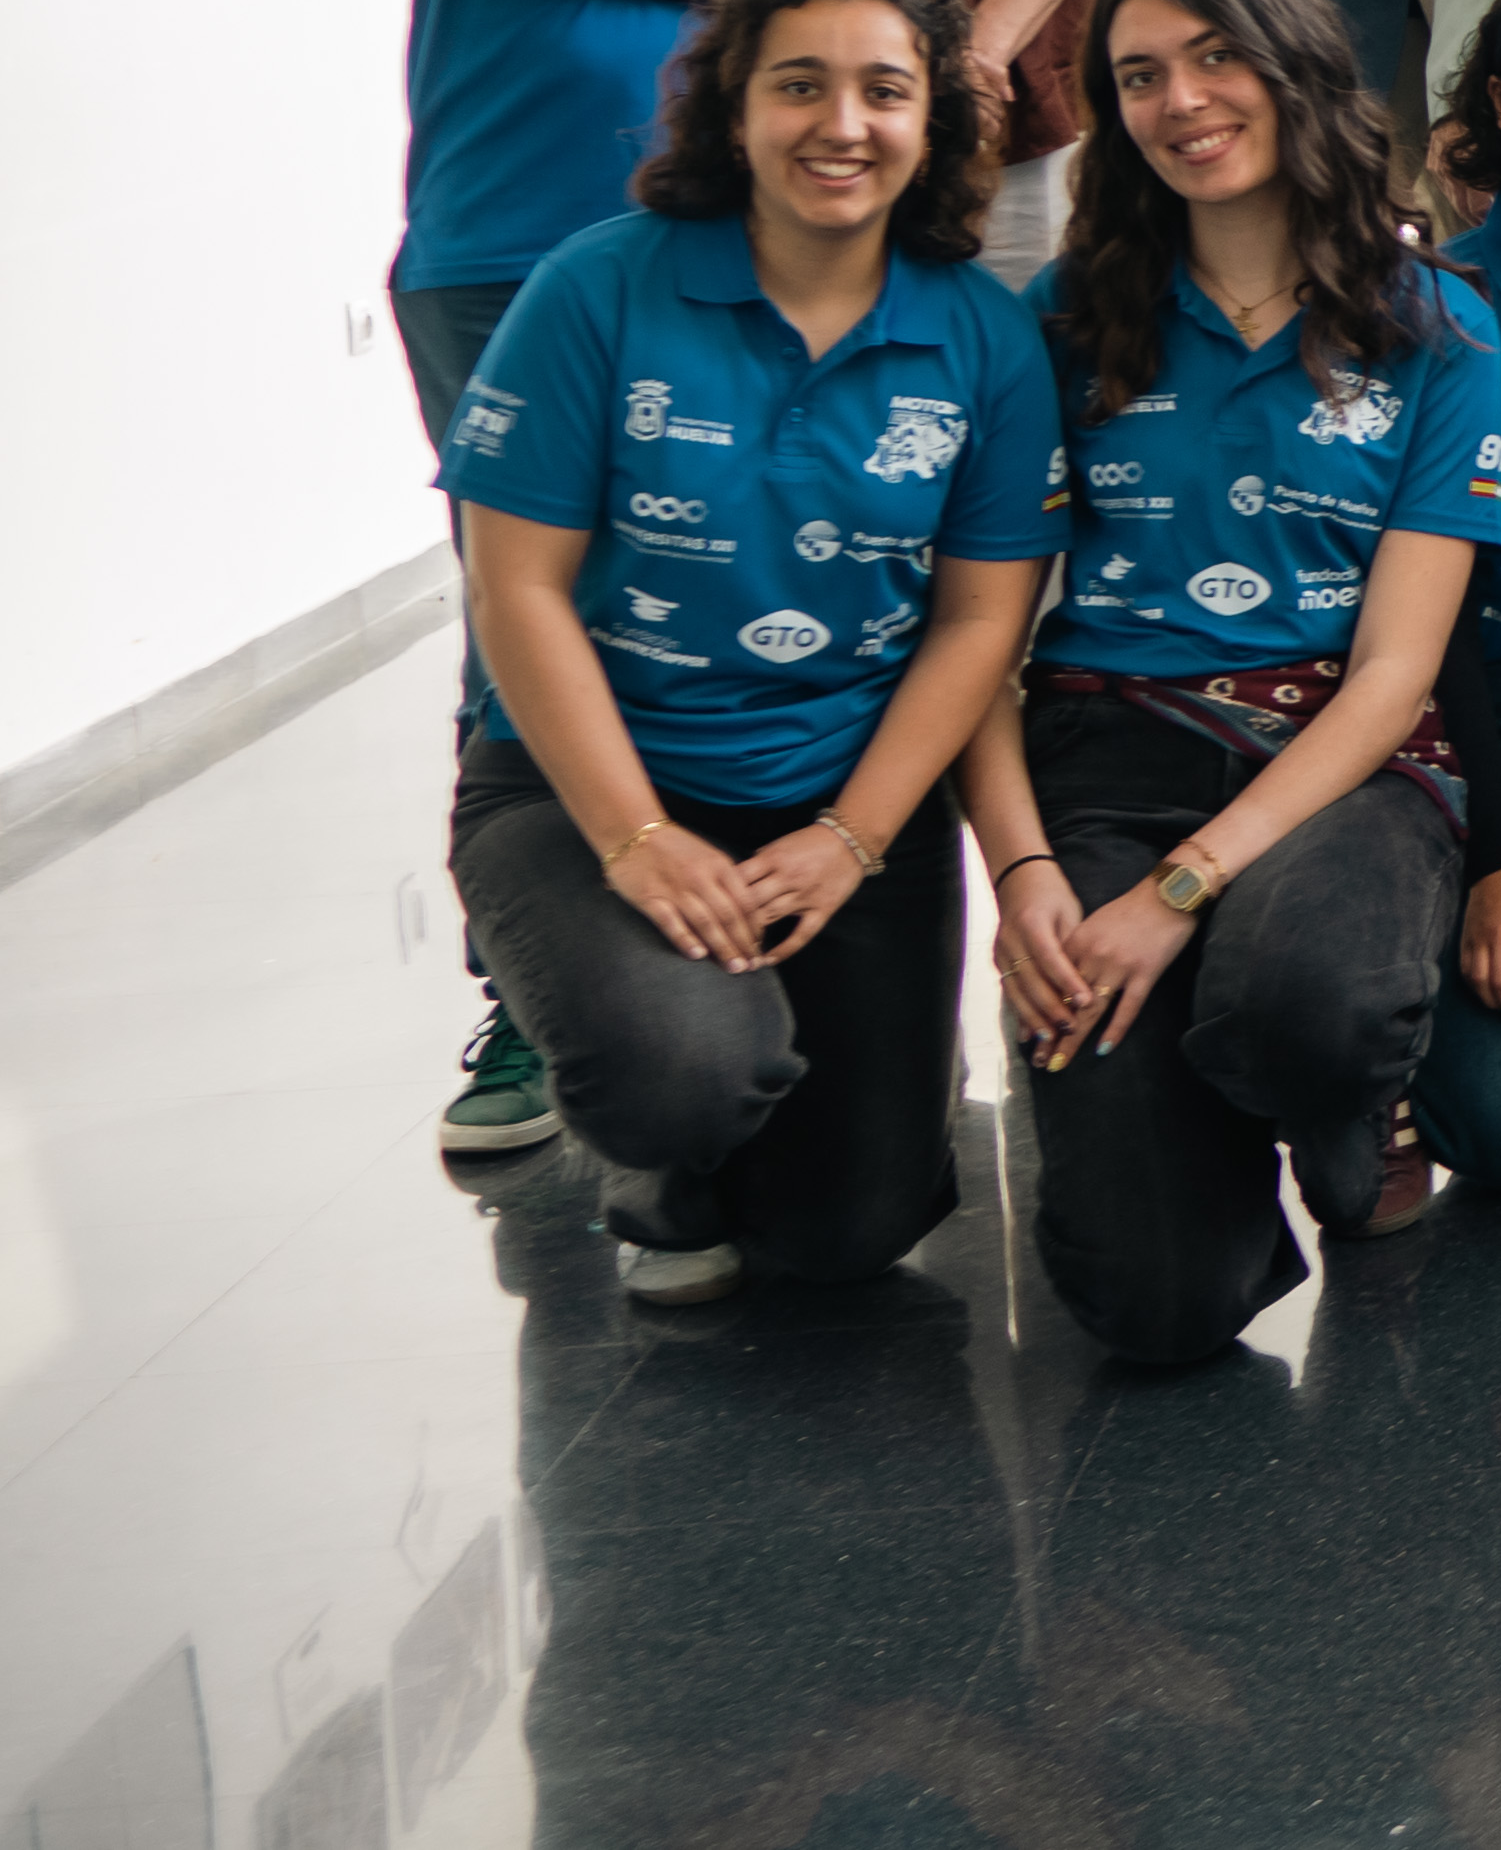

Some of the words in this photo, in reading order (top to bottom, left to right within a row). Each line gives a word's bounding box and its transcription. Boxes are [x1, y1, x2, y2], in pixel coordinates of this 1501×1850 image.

[1318, 493, 1337, 507] de
[1199, 577, 1259, 600] GTO
[751, 626, 818, 647] GTO
